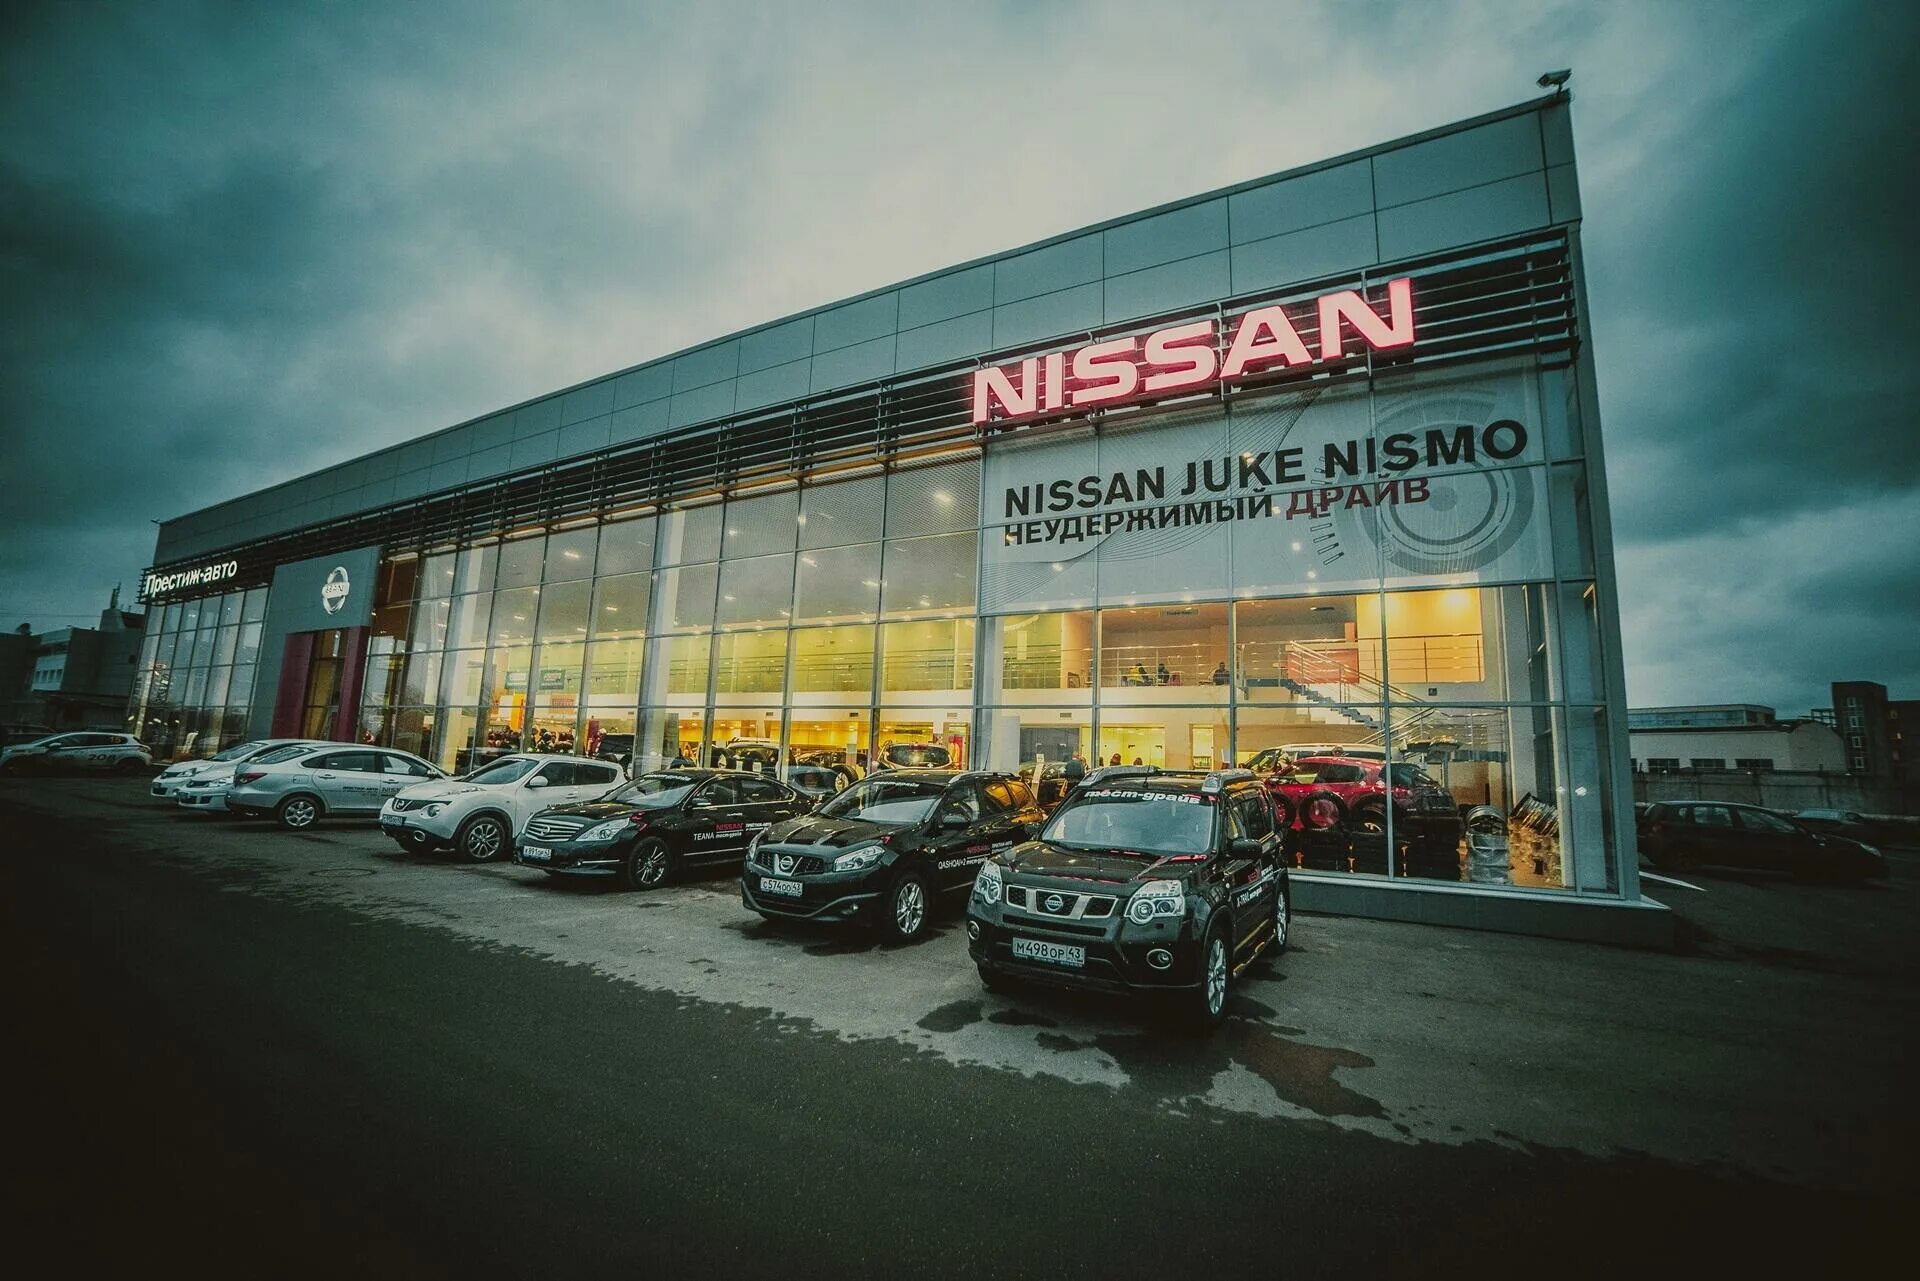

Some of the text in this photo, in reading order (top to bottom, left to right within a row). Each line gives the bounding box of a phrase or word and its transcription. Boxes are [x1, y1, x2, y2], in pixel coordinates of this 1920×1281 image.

[973, 277, 1415, 425] NISSAN
[1005, 419, 1528, 517] NISSAN JUKE NISMO
[1004, 474, 1430, 547] НЕУДЕРЖИМЫЙ ДРАЙВ
[693, 832, 715, 841] TEANA
[1068, 948, 1081, 959] 43
